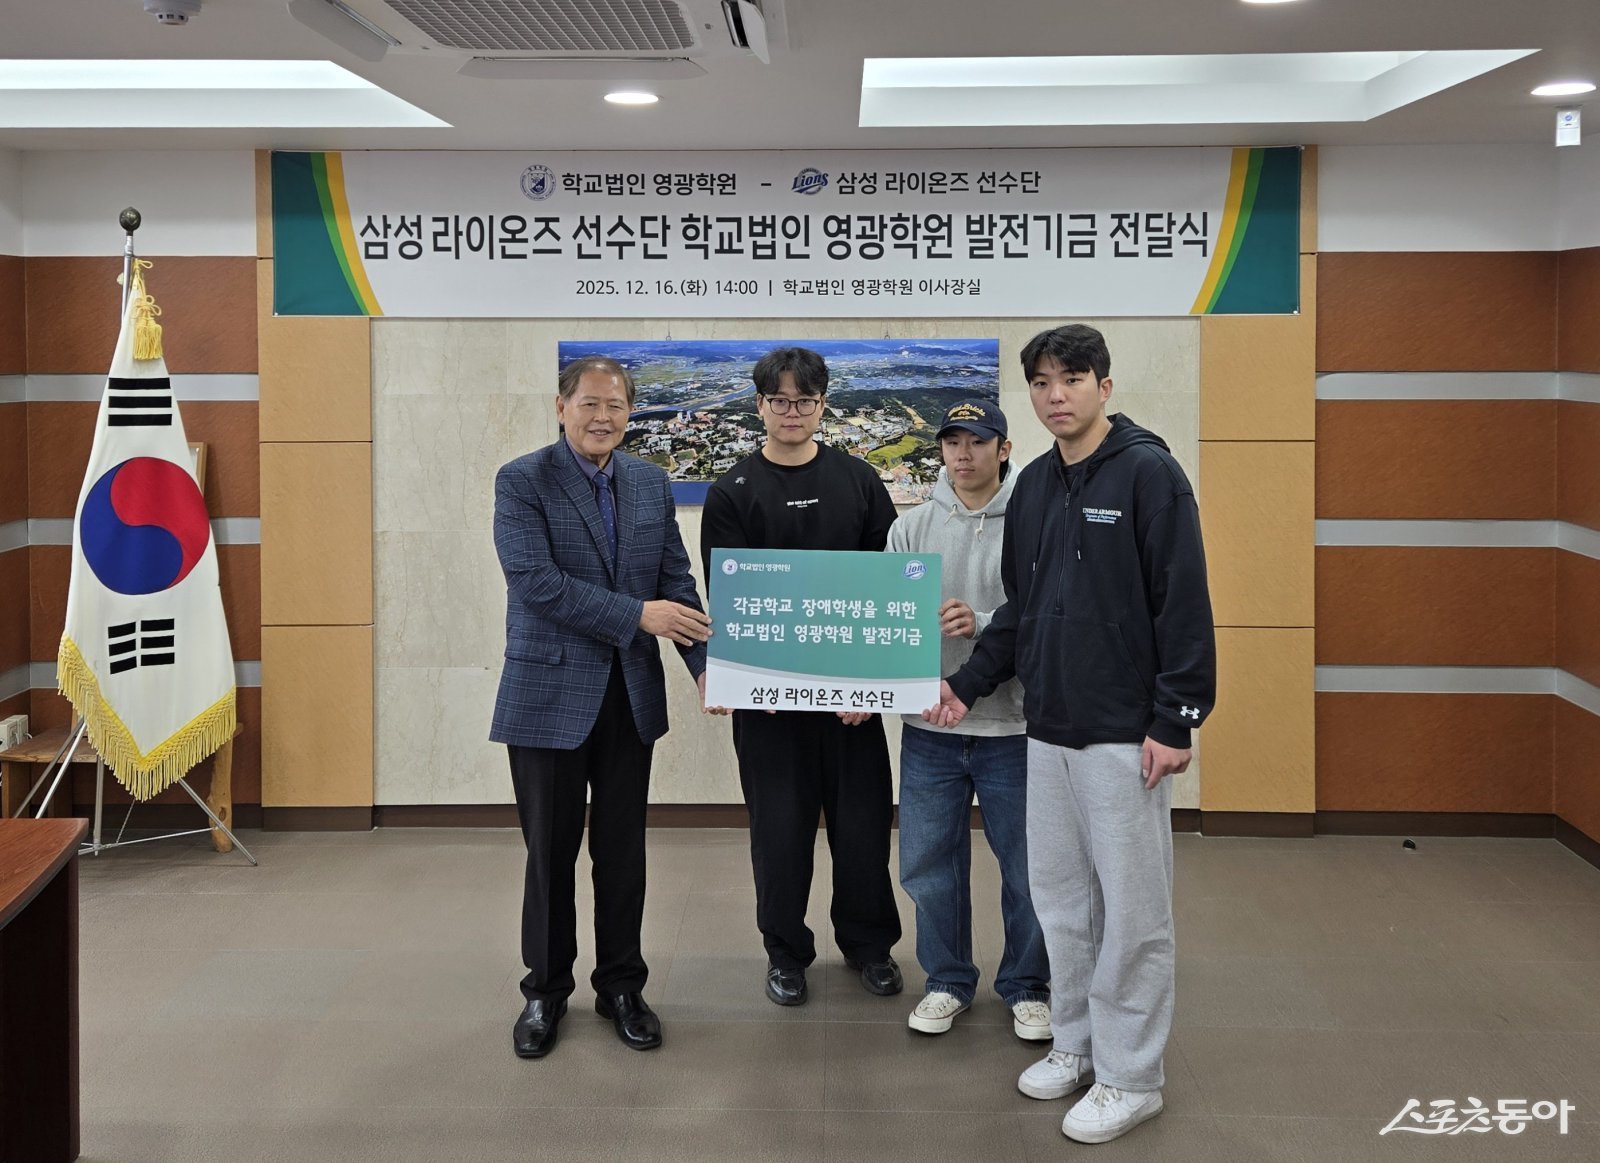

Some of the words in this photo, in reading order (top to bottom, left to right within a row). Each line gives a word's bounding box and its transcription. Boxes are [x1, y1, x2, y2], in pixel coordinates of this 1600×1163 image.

[562, 172, 645, 196] 학교법인
[653, 172, 737, 196] 영광학원
[791, 172, 829, 193] Lions
[837, 171, 877, 195] 삼성
[886, 171, 969, 195] 라이온즈
[977, 170, 1042, 194] 선수단
[359, 214, 423, 261] 삼성
[432, 214, 562, 261] 라이온즈
[572, 214, 671, 261] 선수단
[680, 213, 810, 261] 학교법인
[823, 213, 953, 261] 영광학원
[966, 213, 1098, 260] 발전기금
[1110, 212, 1209, 259] 전달식
[576, 279, 620, 295] 2025.
[627, 279, 649, 295] 12.
[716, 279, 759, 295] 14:00
[782, 279, 844, 296] 학교법인
[851, 279, 913, 296] 영광학원
[919, 279, 981, 296] 이사장실
[732, 597, 793, 616] 각급학교
[801, 598, 878, 619] 장애학생을
[886, 601, 917, 620] 위한
[726, 622, 785, 642] 학교법인
[794, 624, 853, 644] 영광학원
[862, 626, 923, 646] 발전기금
[750, 686, 780, 705] 삼성
[785, 687, 844, 706] 라이온즈
[850, 689, 895, 708] 선수단
